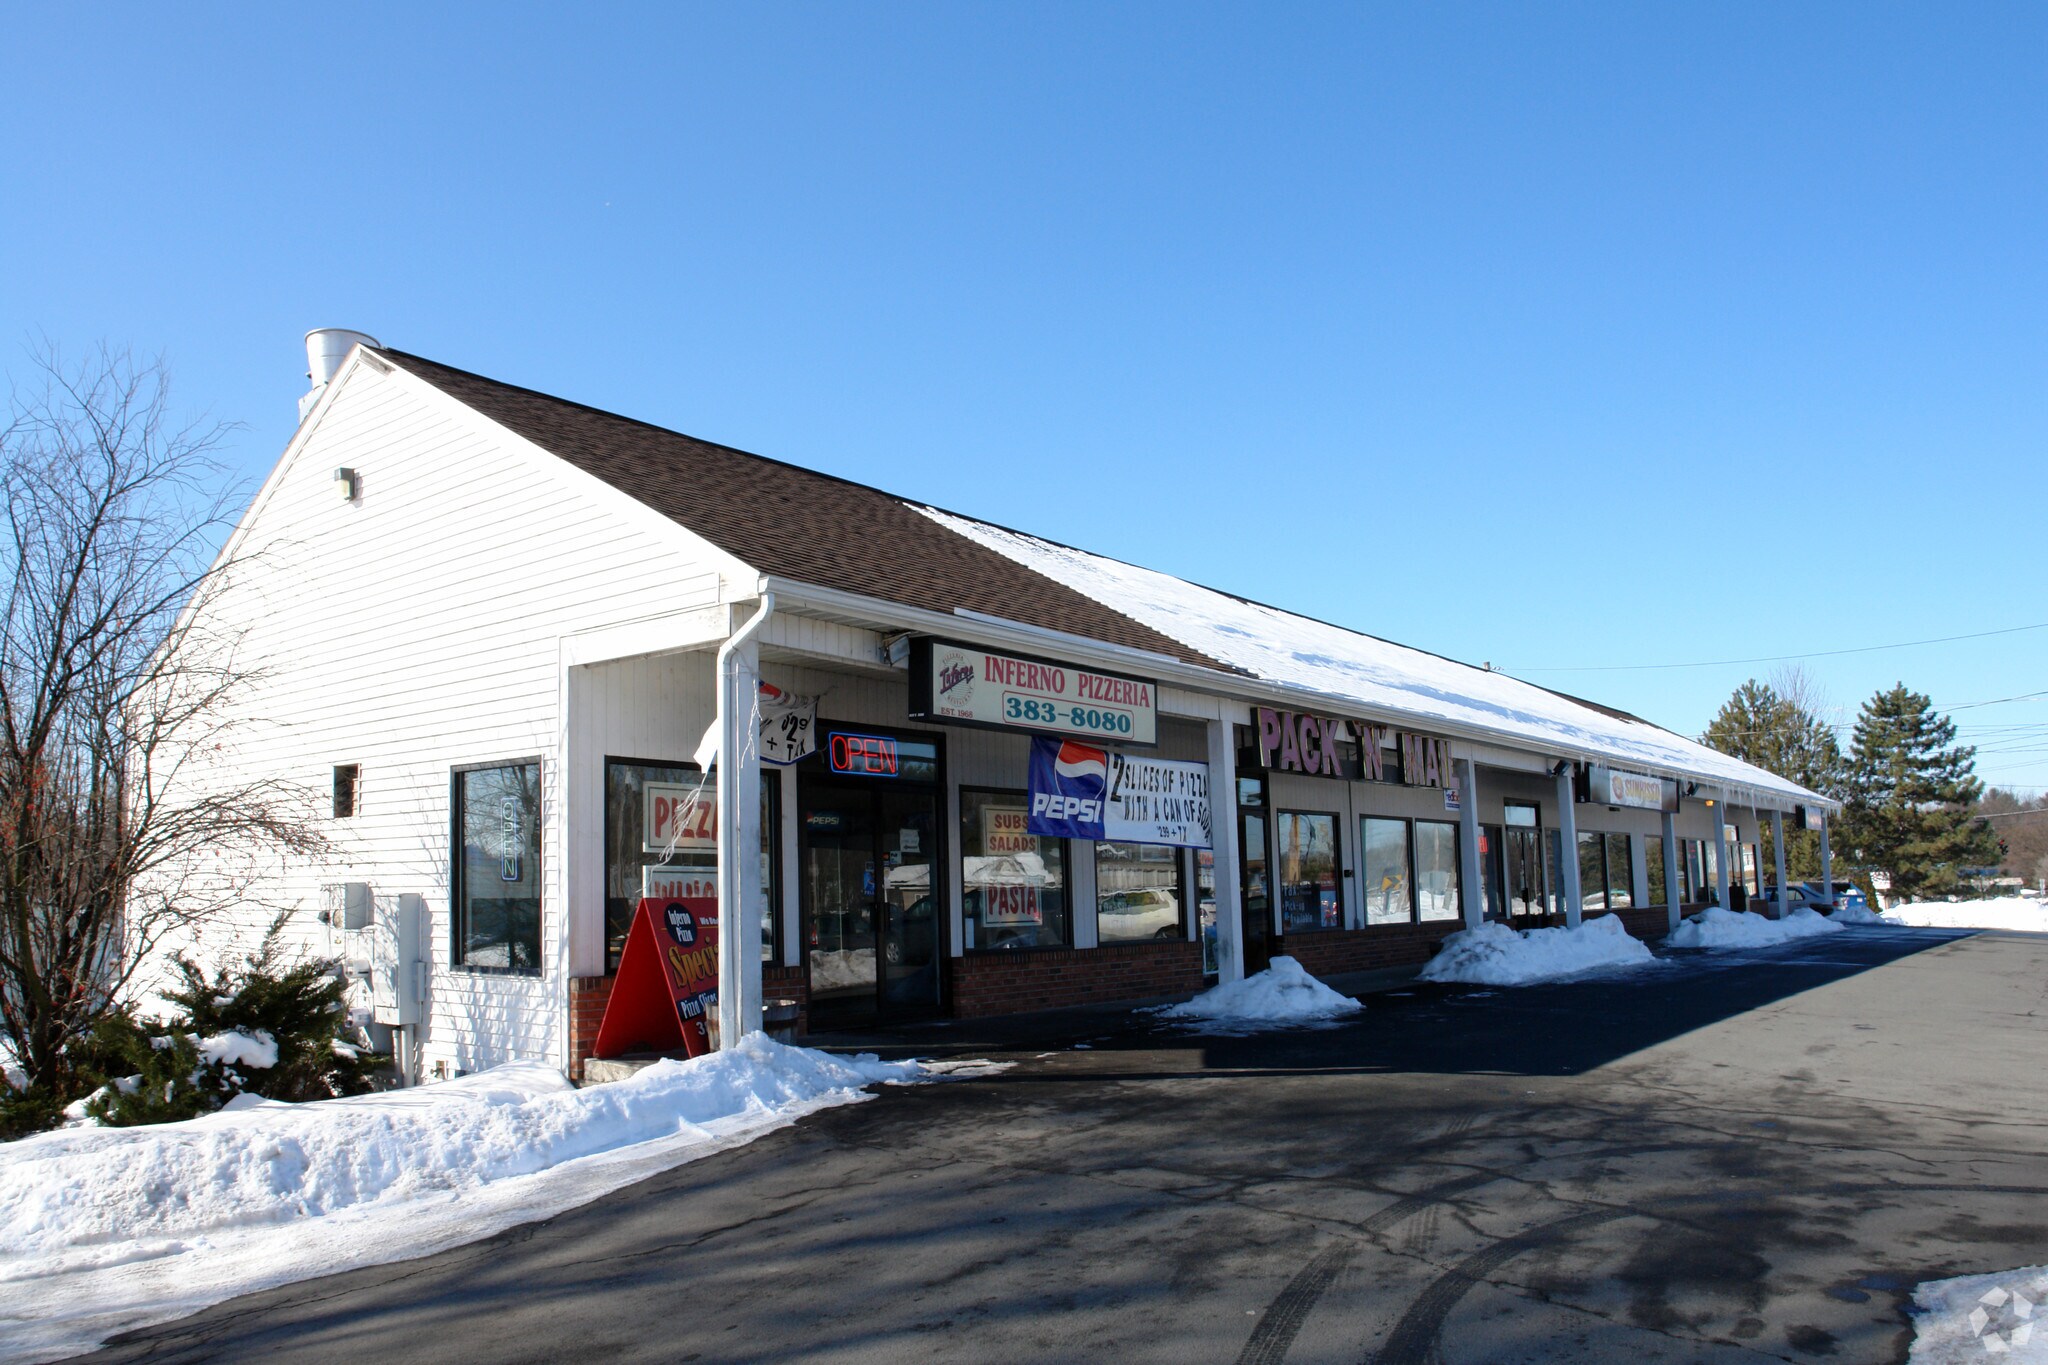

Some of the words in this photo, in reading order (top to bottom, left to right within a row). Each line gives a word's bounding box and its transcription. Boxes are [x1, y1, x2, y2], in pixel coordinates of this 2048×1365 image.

[984, 656, 1065, 694] INFERNO
[1078, 674, 1150, 707] PIZZERIA
[1006, 697, 1131, 734] 383-8080
[786, 734, 806, 761] TAX
[831, 735, 896, 774] OPEN
[1256, 706, 1342, 777] PACK
[1400, 732, 1460, 790] MAIL
[1110, 752, 1125, 803] 2
[1124, 764, 1160, 793] SLICES
[1162, 768, 1174, 793] OF
[1179, 770, 1207, 799] PIZZA
[812, 816, 840, 825] PEPSI
[994, 814, 1028, 829] SUBS
[1032, 793, 1101, 824] PEPSI
[1124, 795, 1148, 821] WITH
[1154, 797, 1160, 822] A
[1163, 797, 1182, 823] CAN
[1184, 799, 1196, 823] OF
[502, 802, 514, 876] OPEN
[989, 836, 1036, 852] SALADS
[1178, 825, 1188, 842] TX
[988, 883, 1037, 916] PASTA
[668, 910, 692, 927] Inferno
[675, 927, 694, 942] Pizza
[680, 999, 701, 1019] Pizza
[698, 992, 717, 1011] Slices
